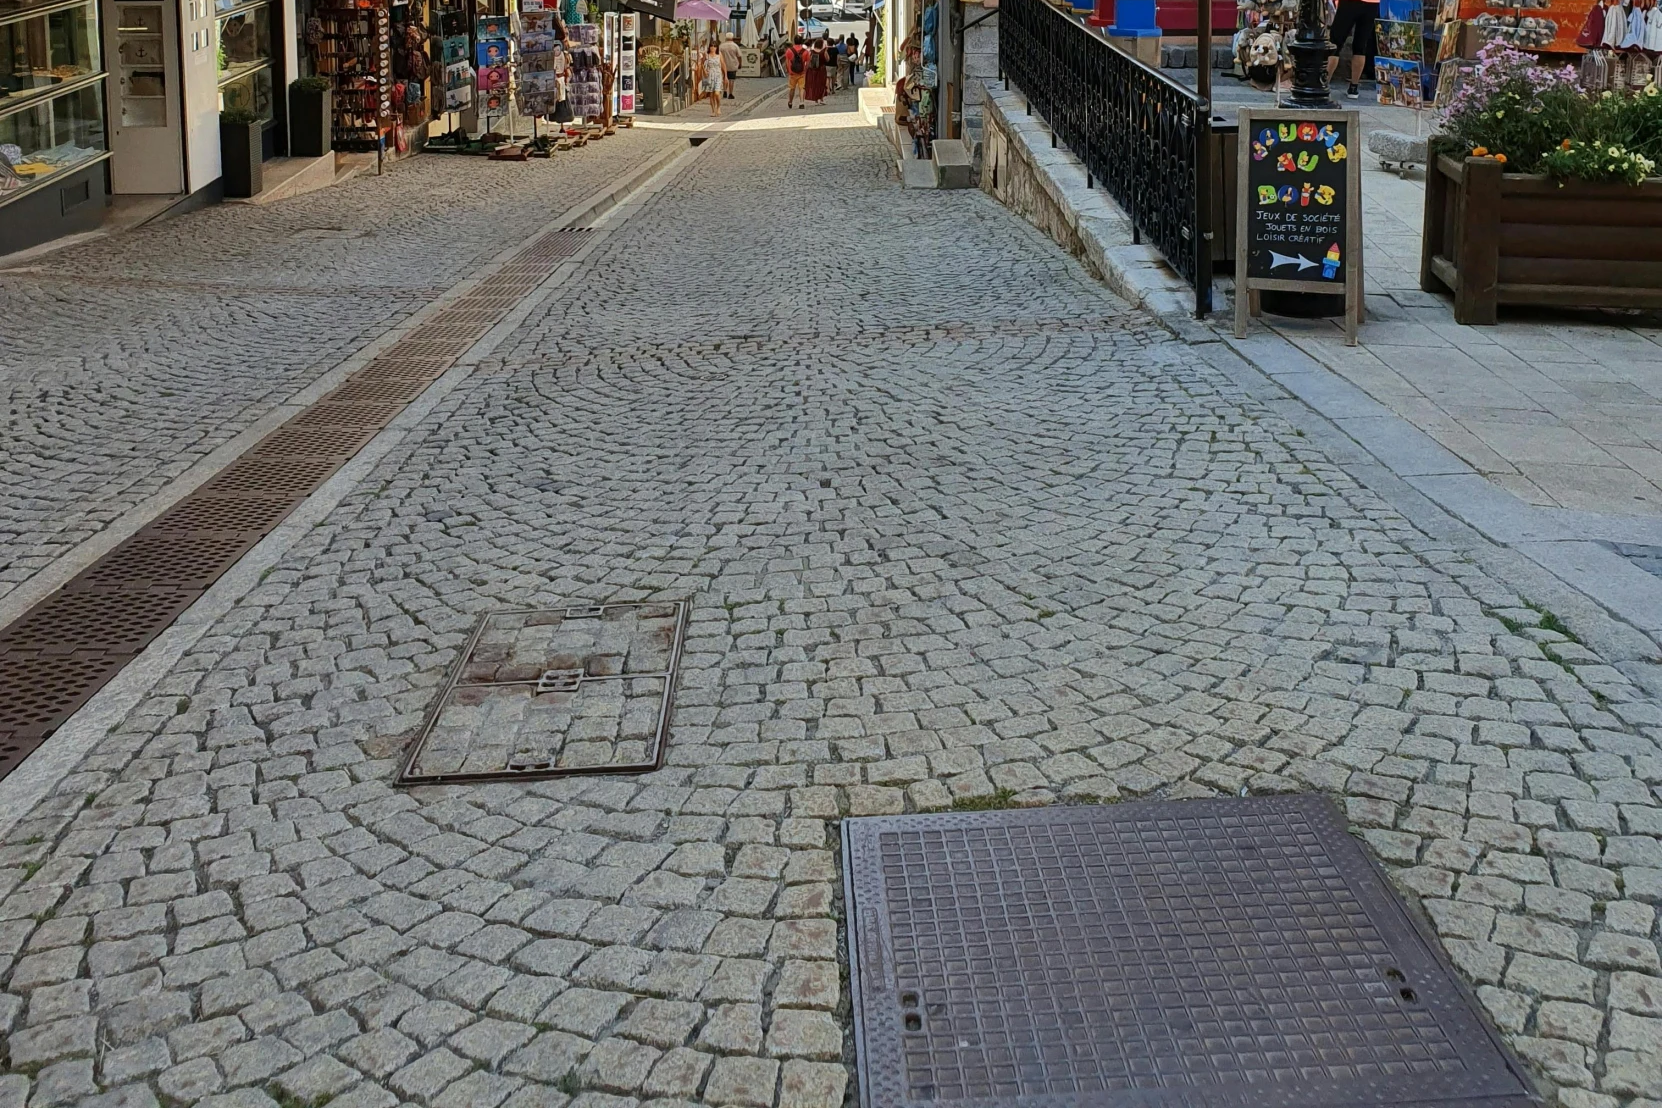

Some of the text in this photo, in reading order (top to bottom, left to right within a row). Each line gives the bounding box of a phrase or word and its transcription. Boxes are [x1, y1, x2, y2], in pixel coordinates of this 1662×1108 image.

[1256, 210, 1281, 220] JEUX
[1285, 213, 1298, 222] DE
[1265, 223, 1297, 232] JOUETS
[1300, 225, 1312, 233] EN
